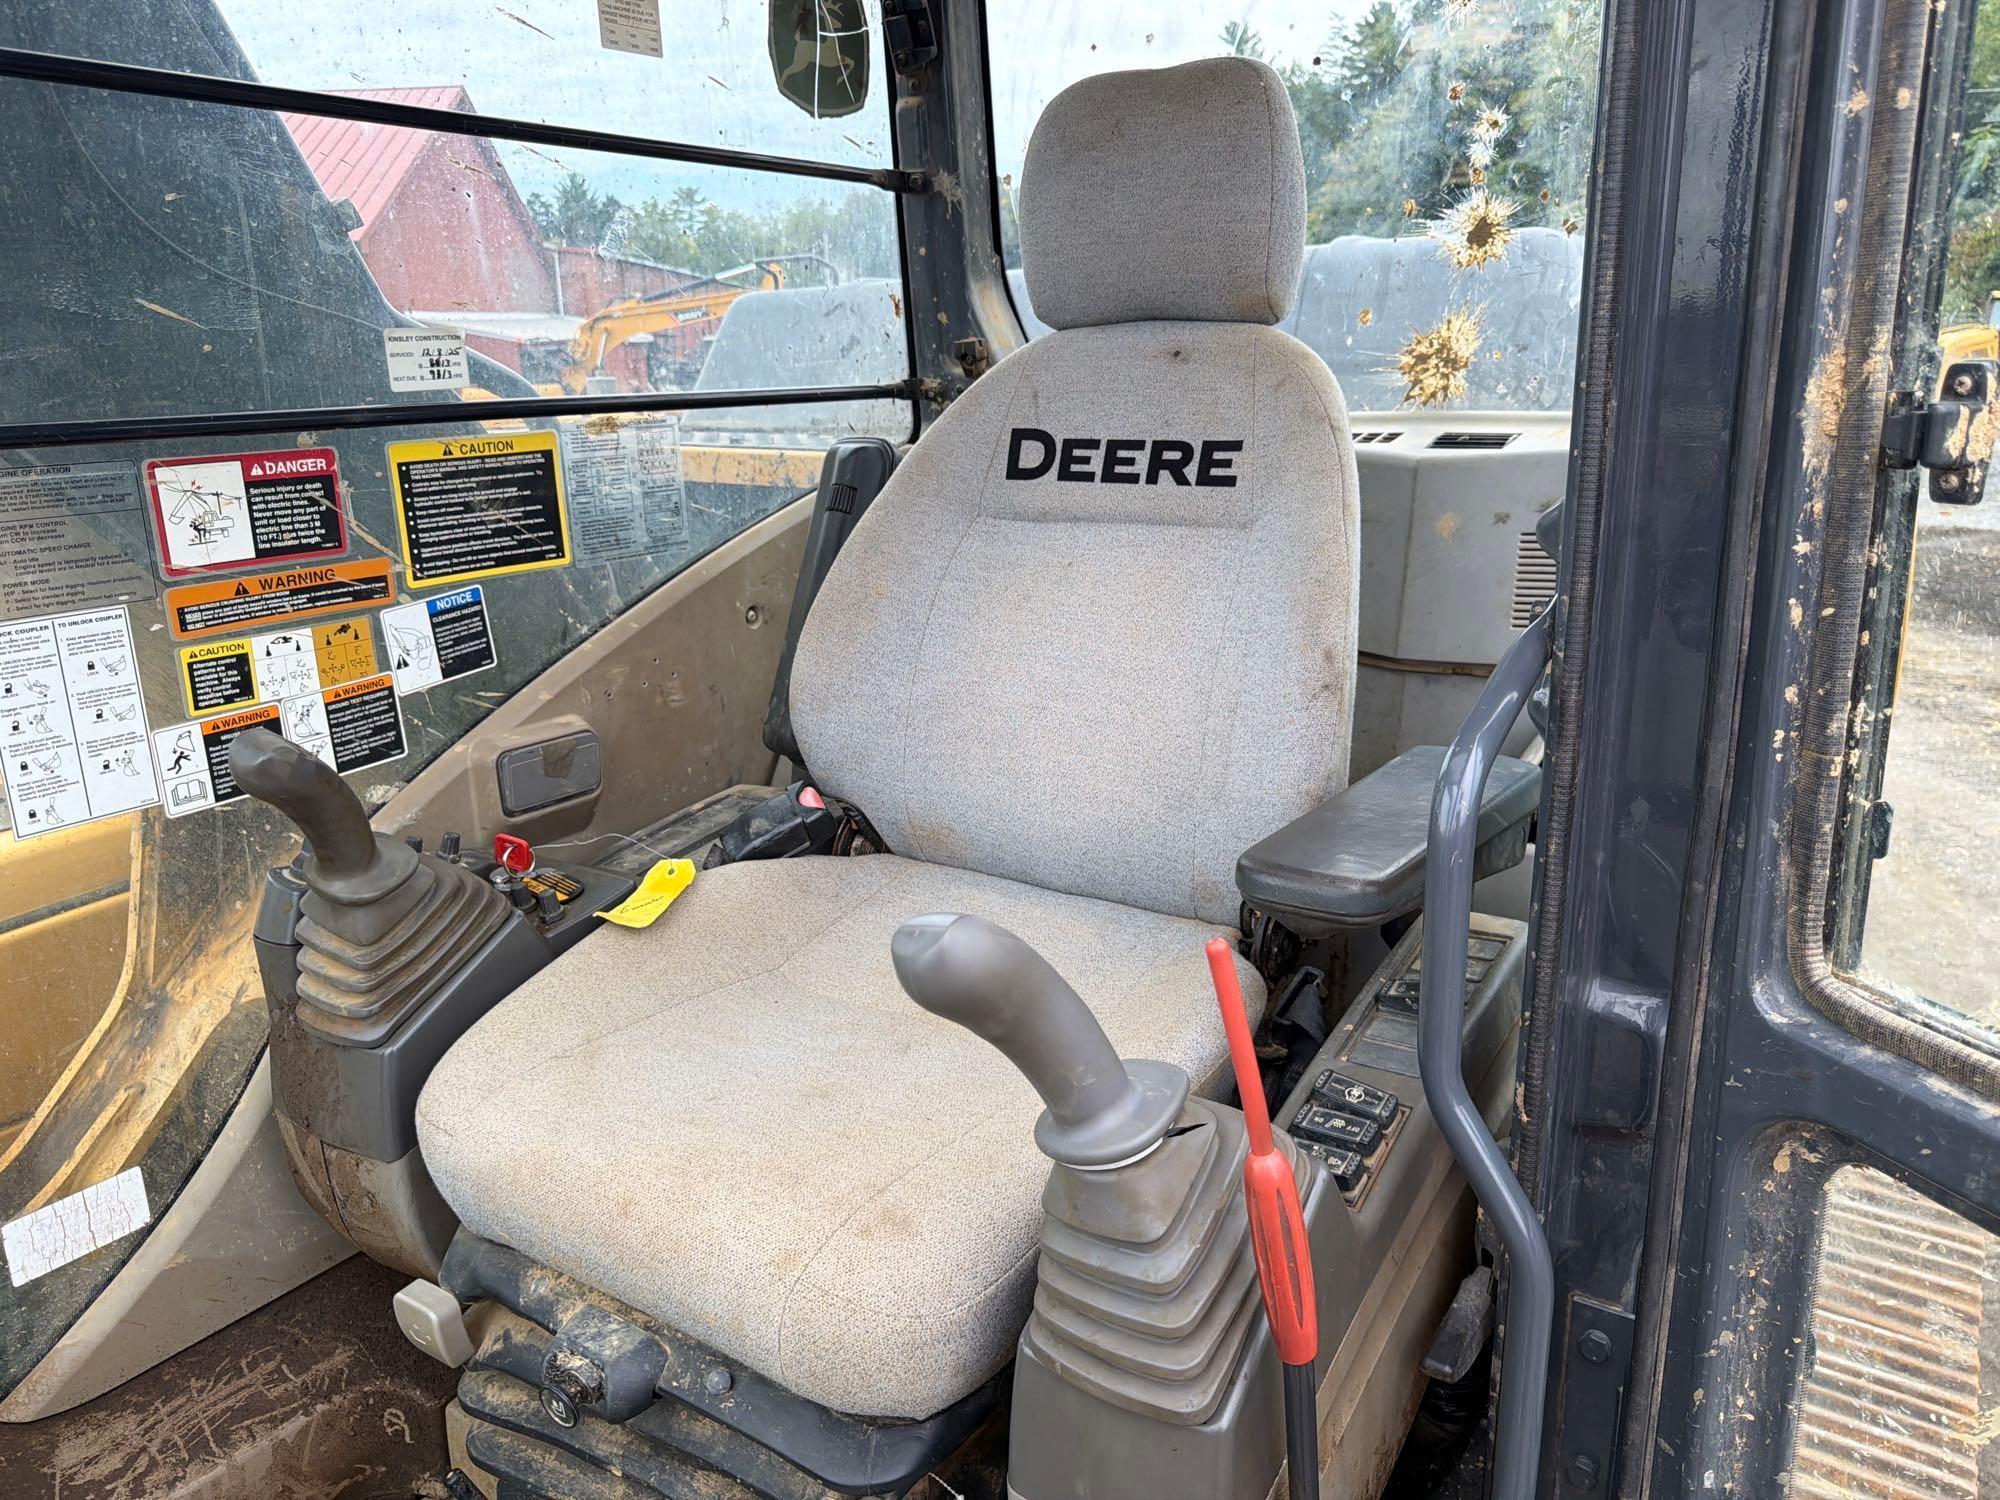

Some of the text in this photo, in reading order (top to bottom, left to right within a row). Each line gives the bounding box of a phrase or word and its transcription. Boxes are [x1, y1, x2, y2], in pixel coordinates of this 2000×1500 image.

[460, 440, 513, 455] CAUTION
[1006, 428, 1244, 487] DEERE
[22, 467, 71, 476] OPERATION
[265, 459, 326, 474] DANGER
[277, 485, 294, 493] injury
[265, 493, 283, 501] result
[268, 501, 291, 509] electric
[306, 505, 318, 514] part
[256, 525, 279, 533] electric
[272, 538, 299, 547] insulator
[301, 535, 322, 544] length.
[64, 557, 96, 565] temporarily
[259, 569, 335, 591] WARNING
[436, 592, 473, 609] NOTICE
[68, 618, 93, 626] UNLOCK
[95, 613, 122, 622] COUPLER
[433, 611, 460, 623] CLEARANCE
[15, 625, 49, 635] COUPLER
[199, 643, 244, 656] CAUTION
[194, 668, 215, 676] patterns
[342, 679, 384, 697] WARNING
[199, 698, 225, 707] operating.
[328, 700, 349, 710] GROUND
[221, 710, 270, 728] WARNING
